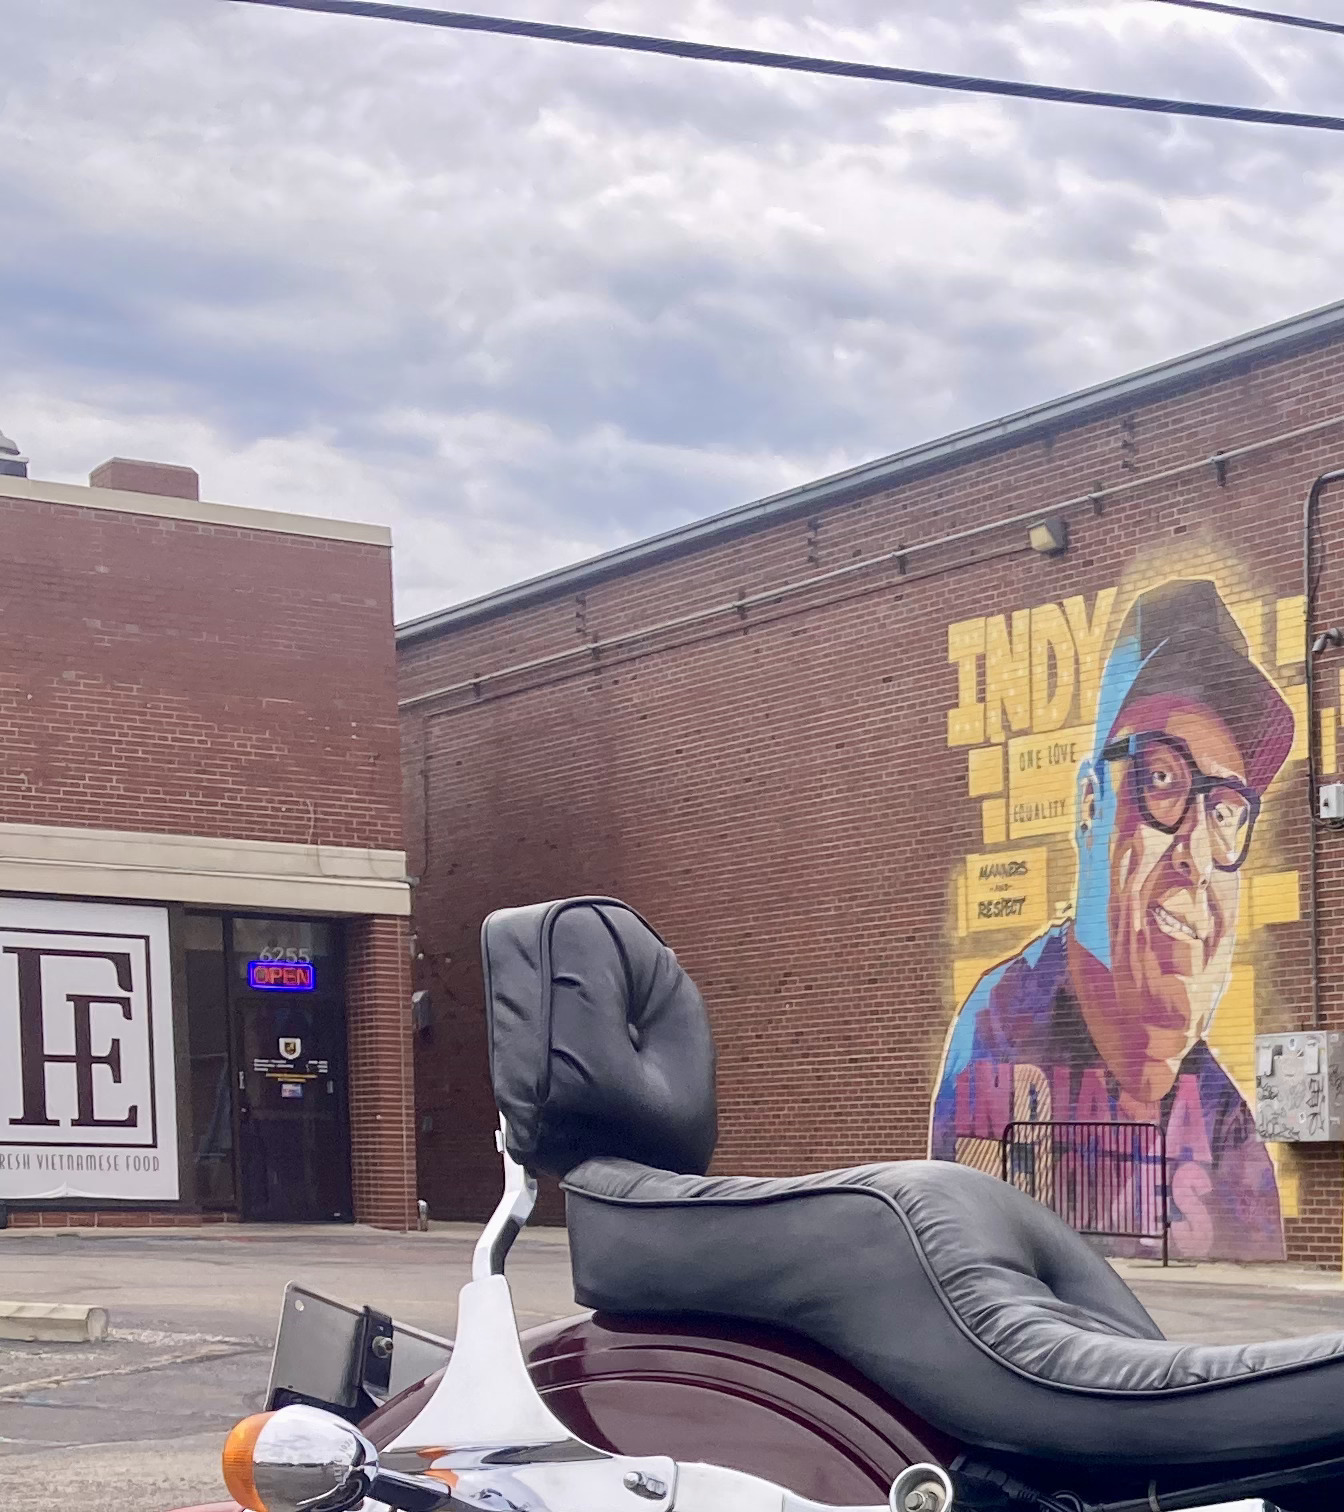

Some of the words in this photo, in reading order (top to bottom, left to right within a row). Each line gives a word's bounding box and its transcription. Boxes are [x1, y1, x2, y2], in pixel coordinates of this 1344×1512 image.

[947, 586, 1118, 748] INDY
[1019, 749, 1042, 772] ONE
[1048, 742, 1077, 766] LOVE
[1013, 800, 1066, 824] EQUALITY
[977, 896, 1026, 919] RESPECT
[259, 946, 310, 963] 6255
[253, 966, 310, 985] OPEN
[36, 1153, 120, 1172] VIETNAMESE
[125, 1155, 160, 1173] FOOD
